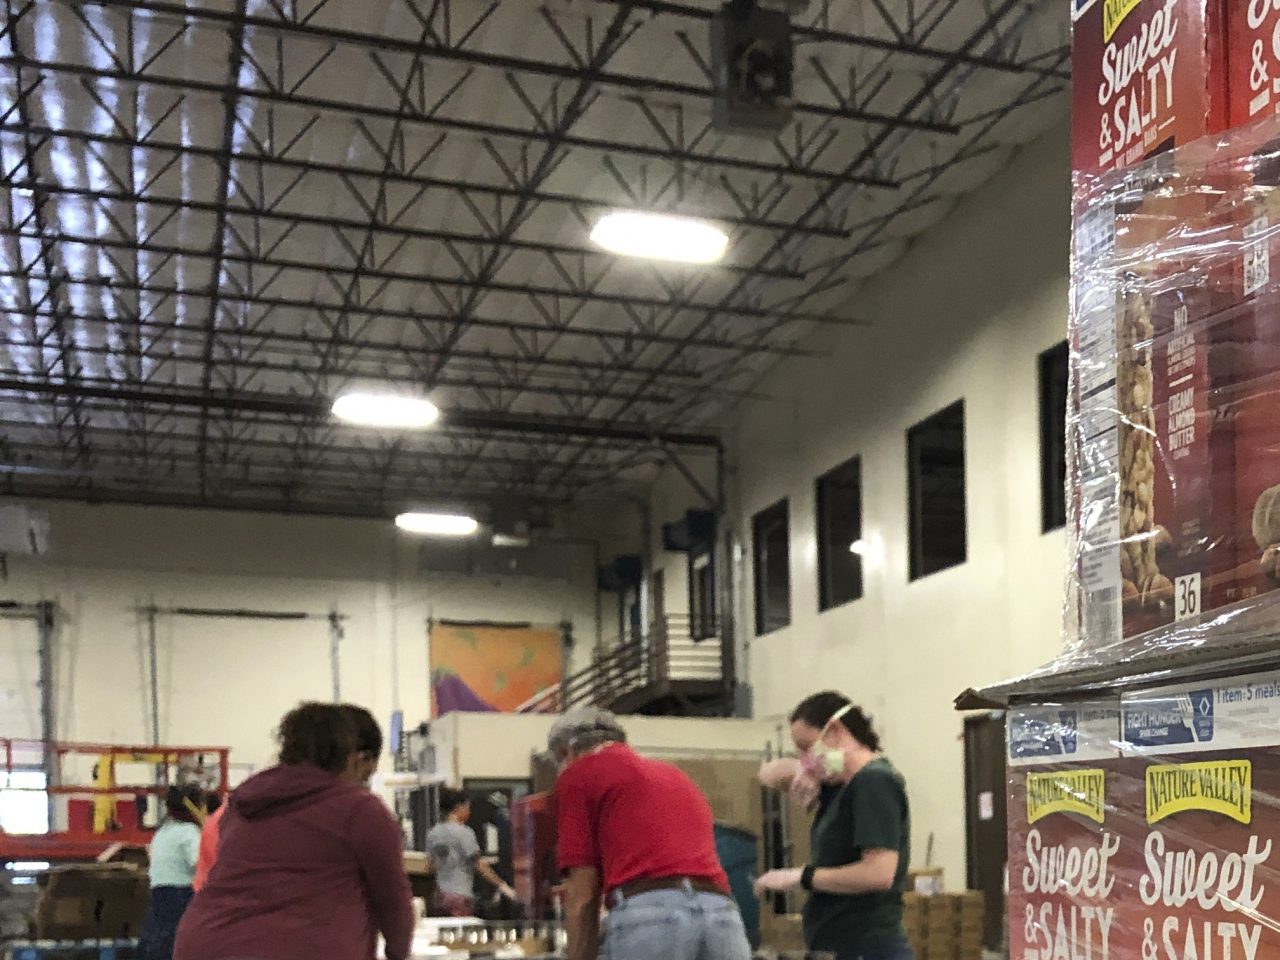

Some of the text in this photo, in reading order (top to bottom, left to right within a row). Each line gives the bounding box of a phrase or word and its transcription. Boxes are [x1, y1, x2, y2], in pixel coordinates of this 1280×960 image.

[1098, 0, 1178, 105] Sweet
[1250, 39, 1270, 91] &
[1100, 48, 1178, 152] & SALTY
[1256, 680, 1280, 700] meals
[1029, 776, 1065, 817] NATURE
[1149, 766, 1249, 816] NATURE VALLEY
[1023, 829, 1121, 899] Sweet
[1138, 830, 1272, 914] Sweet
[1024, 903, 1039, 943] &
